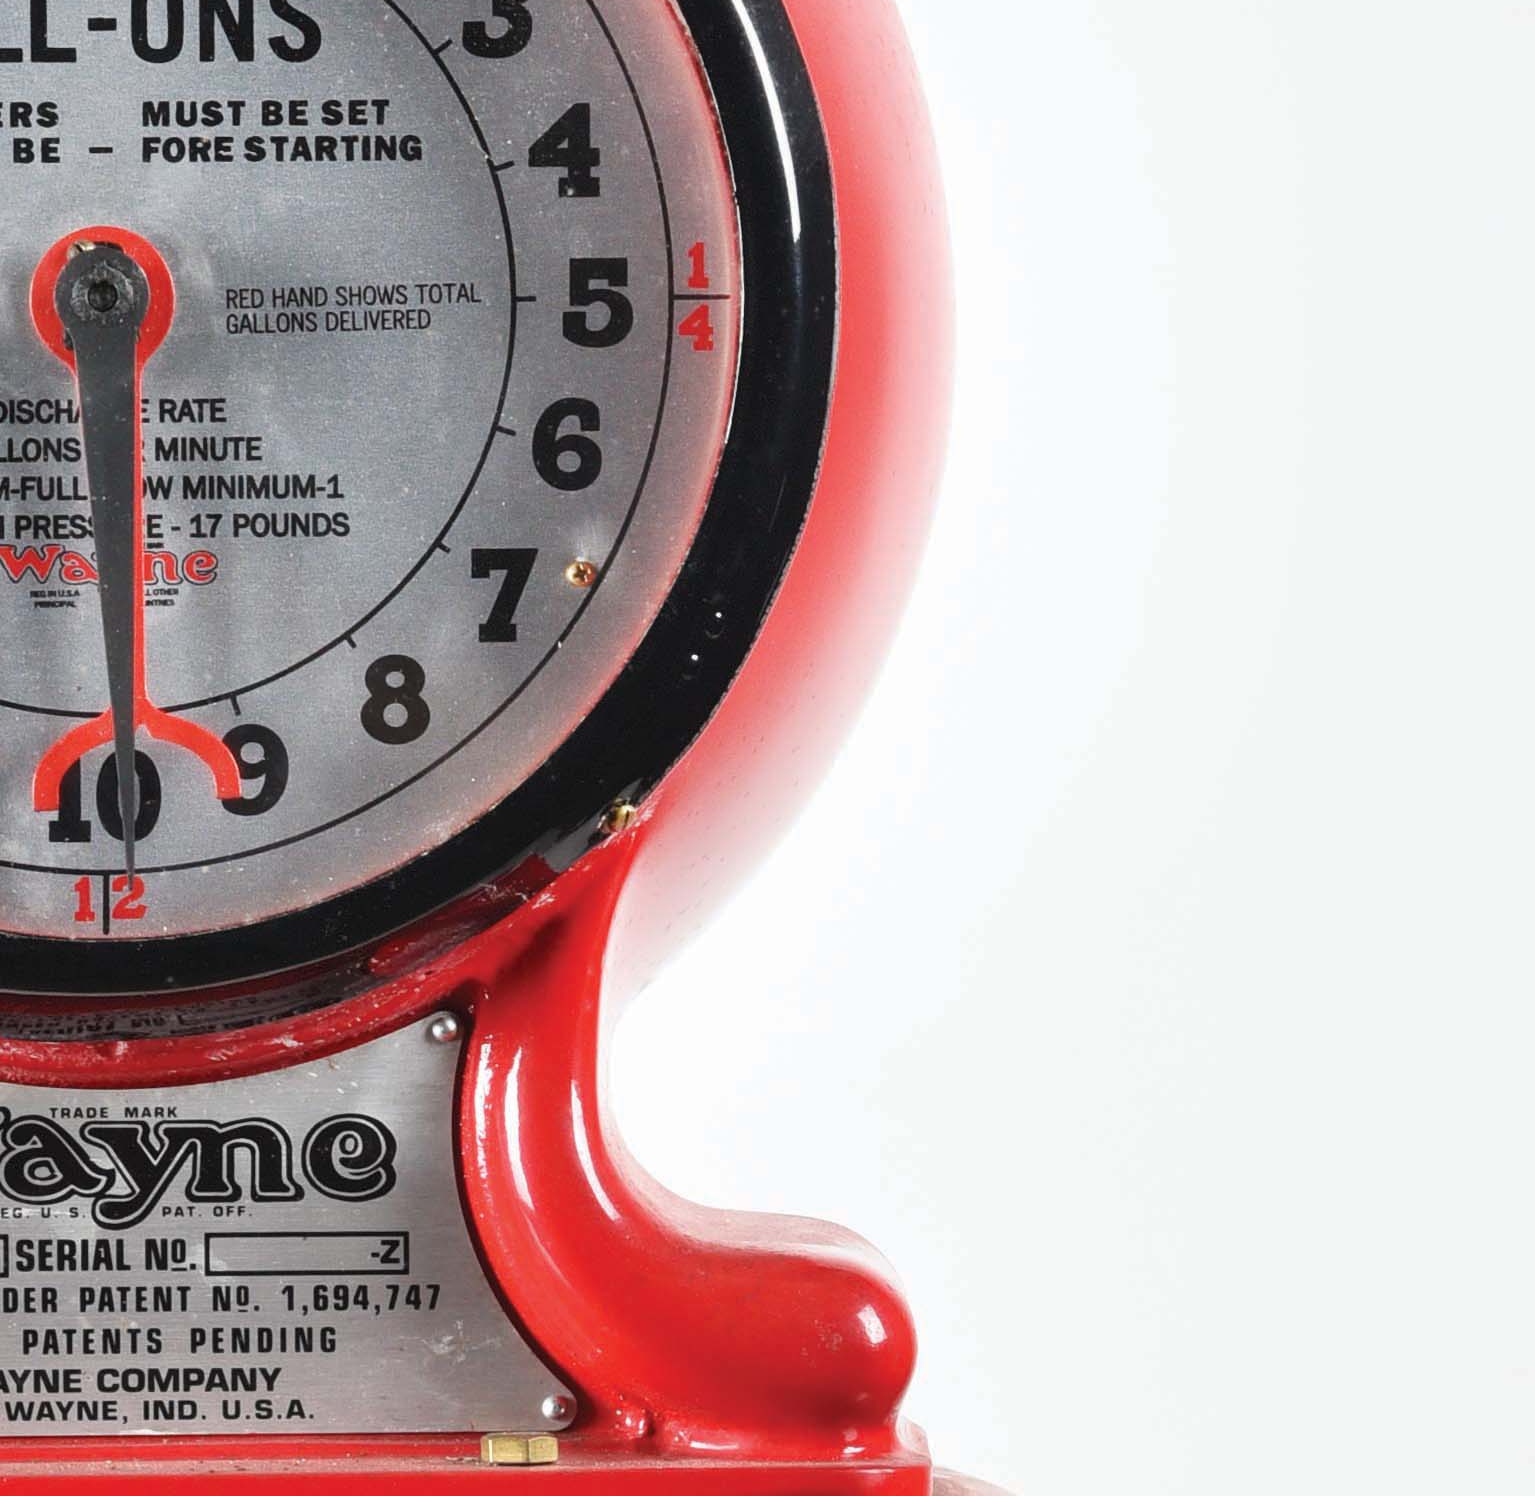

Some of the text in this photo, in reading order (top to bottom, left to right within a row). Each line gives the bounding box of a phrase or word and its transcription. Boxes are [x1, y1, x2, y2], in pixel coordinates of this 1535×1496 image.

[142, 101, 245, 127] MUST
[262, 100, 308, 126] BE
[321, 99, 389, 126] SET
[13, 137, 60, 164] BE
[142, 136, 234, 163] FORE
[244, 135, 422, 162] STARTING
[528, 103, 600, 198] 4
[687, 242, 710, 288] 1
[226, 283, 482, 309] RED HAND SHOWS TOTAL
[562, 258, 633, 348] 5
[227, 309, 431, 334] GALLONS DELIVERED
[677, 304, 714, 351] 4
[159, 398, 227, 423] RATE
[155, 437, 262, 462] MINUTE
[532, 397, 602, 491] 6
[183, 474, 344, 500] MINIMUM-1
[190, 513, 223, 538] 17
[233, 512, 350, 537] POUNDS
[471, 548, 538, 643] 7
[361, 655, 430, 745] 8
[222, 723, 289, 816] 9
[48, 750, 162, 842] 10
[50, 1107, 177, 1118] TRADE MARK
[162, 1206, 202, 1216] PAT.
[214, 1206, 253, 1216] OFF.
[16, 1239, 131, 1272] SERIAL
[370, 1240, 399, 1262] -Z
[80, 1286, 191, 1312] PATENT
[282, 1284, 440, 1315] 1,694,747
[23, 1328, 162, 1355] PATENTS
[191, 1327, 336, 1353] PENDING
[97, 1368, 281, 1393] COMPANY
[5, 1401, 127, 1424] WAYNE,
[144, 1400, 206, 1420] IND.
[222, 1399, 314, 1419] U.S.A.
